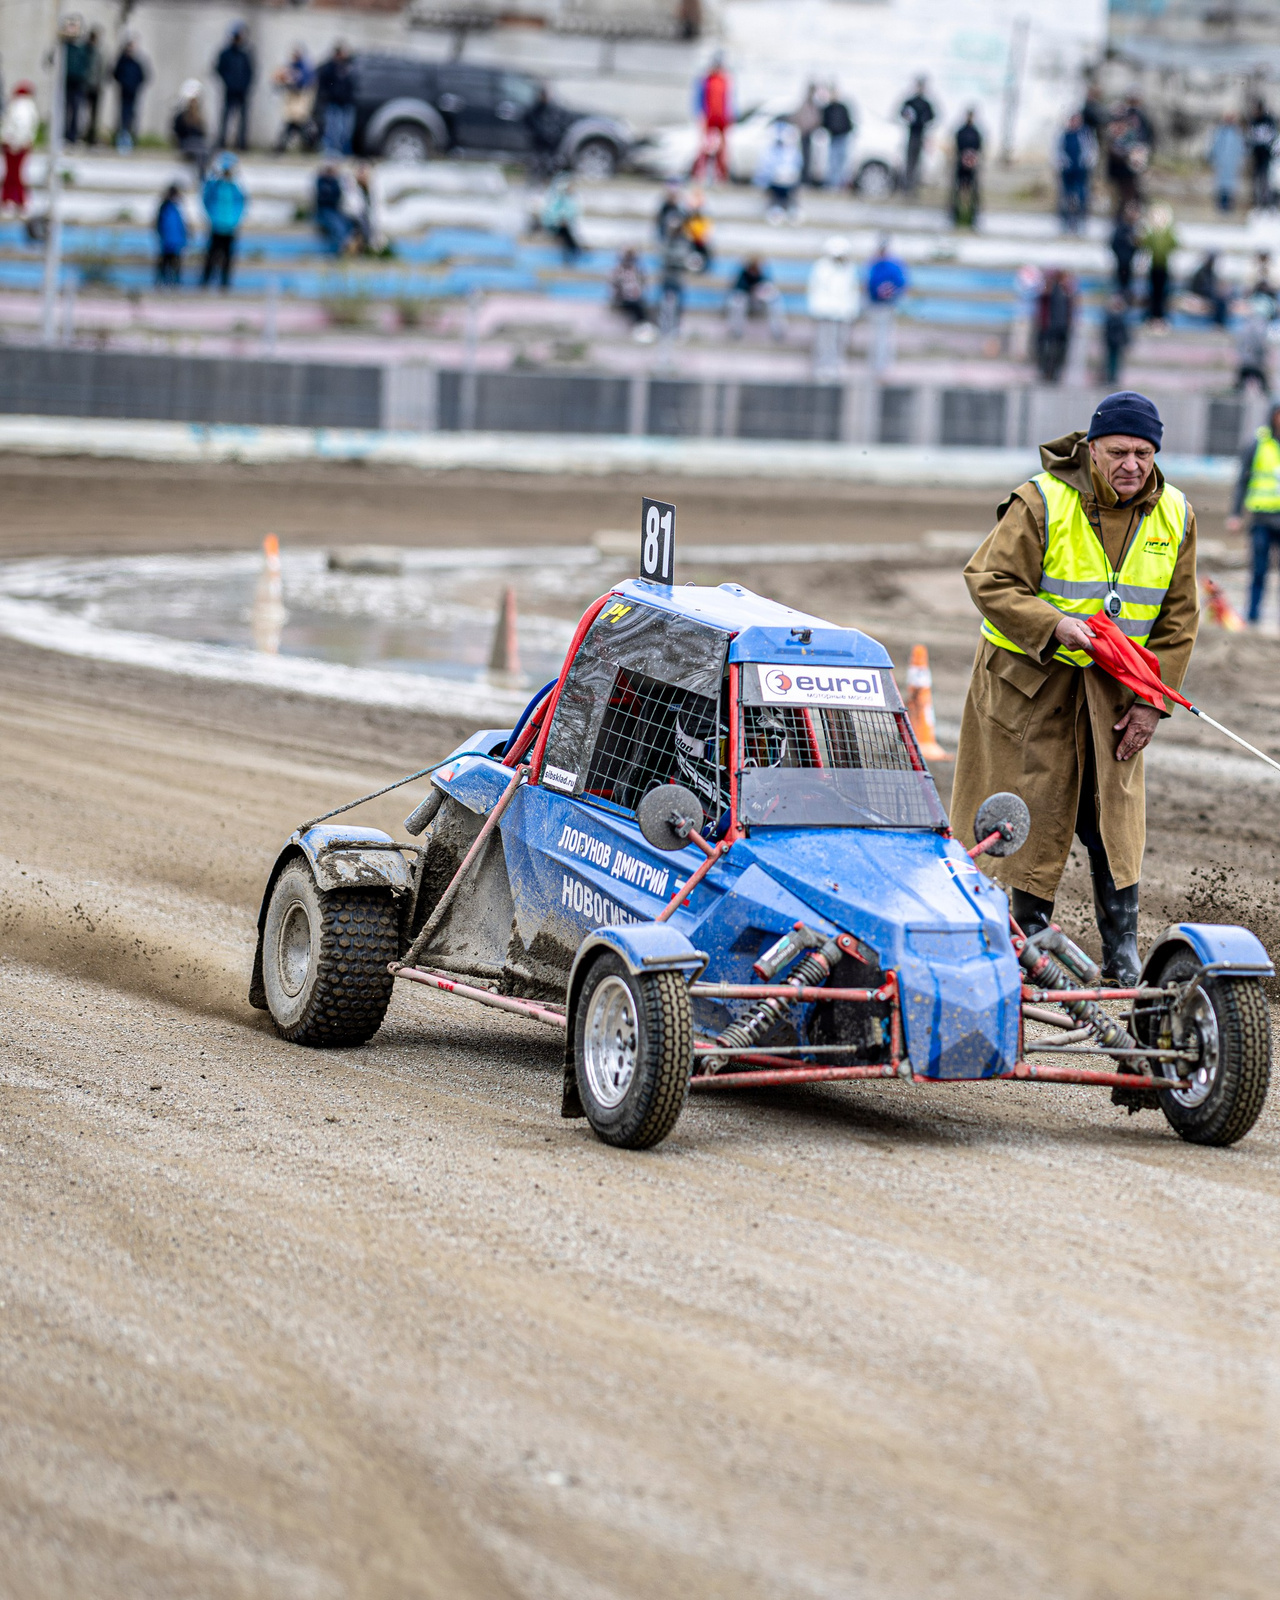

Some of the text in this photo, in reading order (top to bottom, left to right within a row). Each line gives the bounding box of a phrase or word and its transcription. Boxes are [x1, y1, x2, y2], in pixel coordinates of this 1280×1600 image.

[643, 505, 673, 579] 81
[795, 674, 880, 694] eurol
[544, 770, 575, 787] sibsklad.ru
[557, 824, 670, 897] ЛОГУНОВ ДМИТРИЙ
